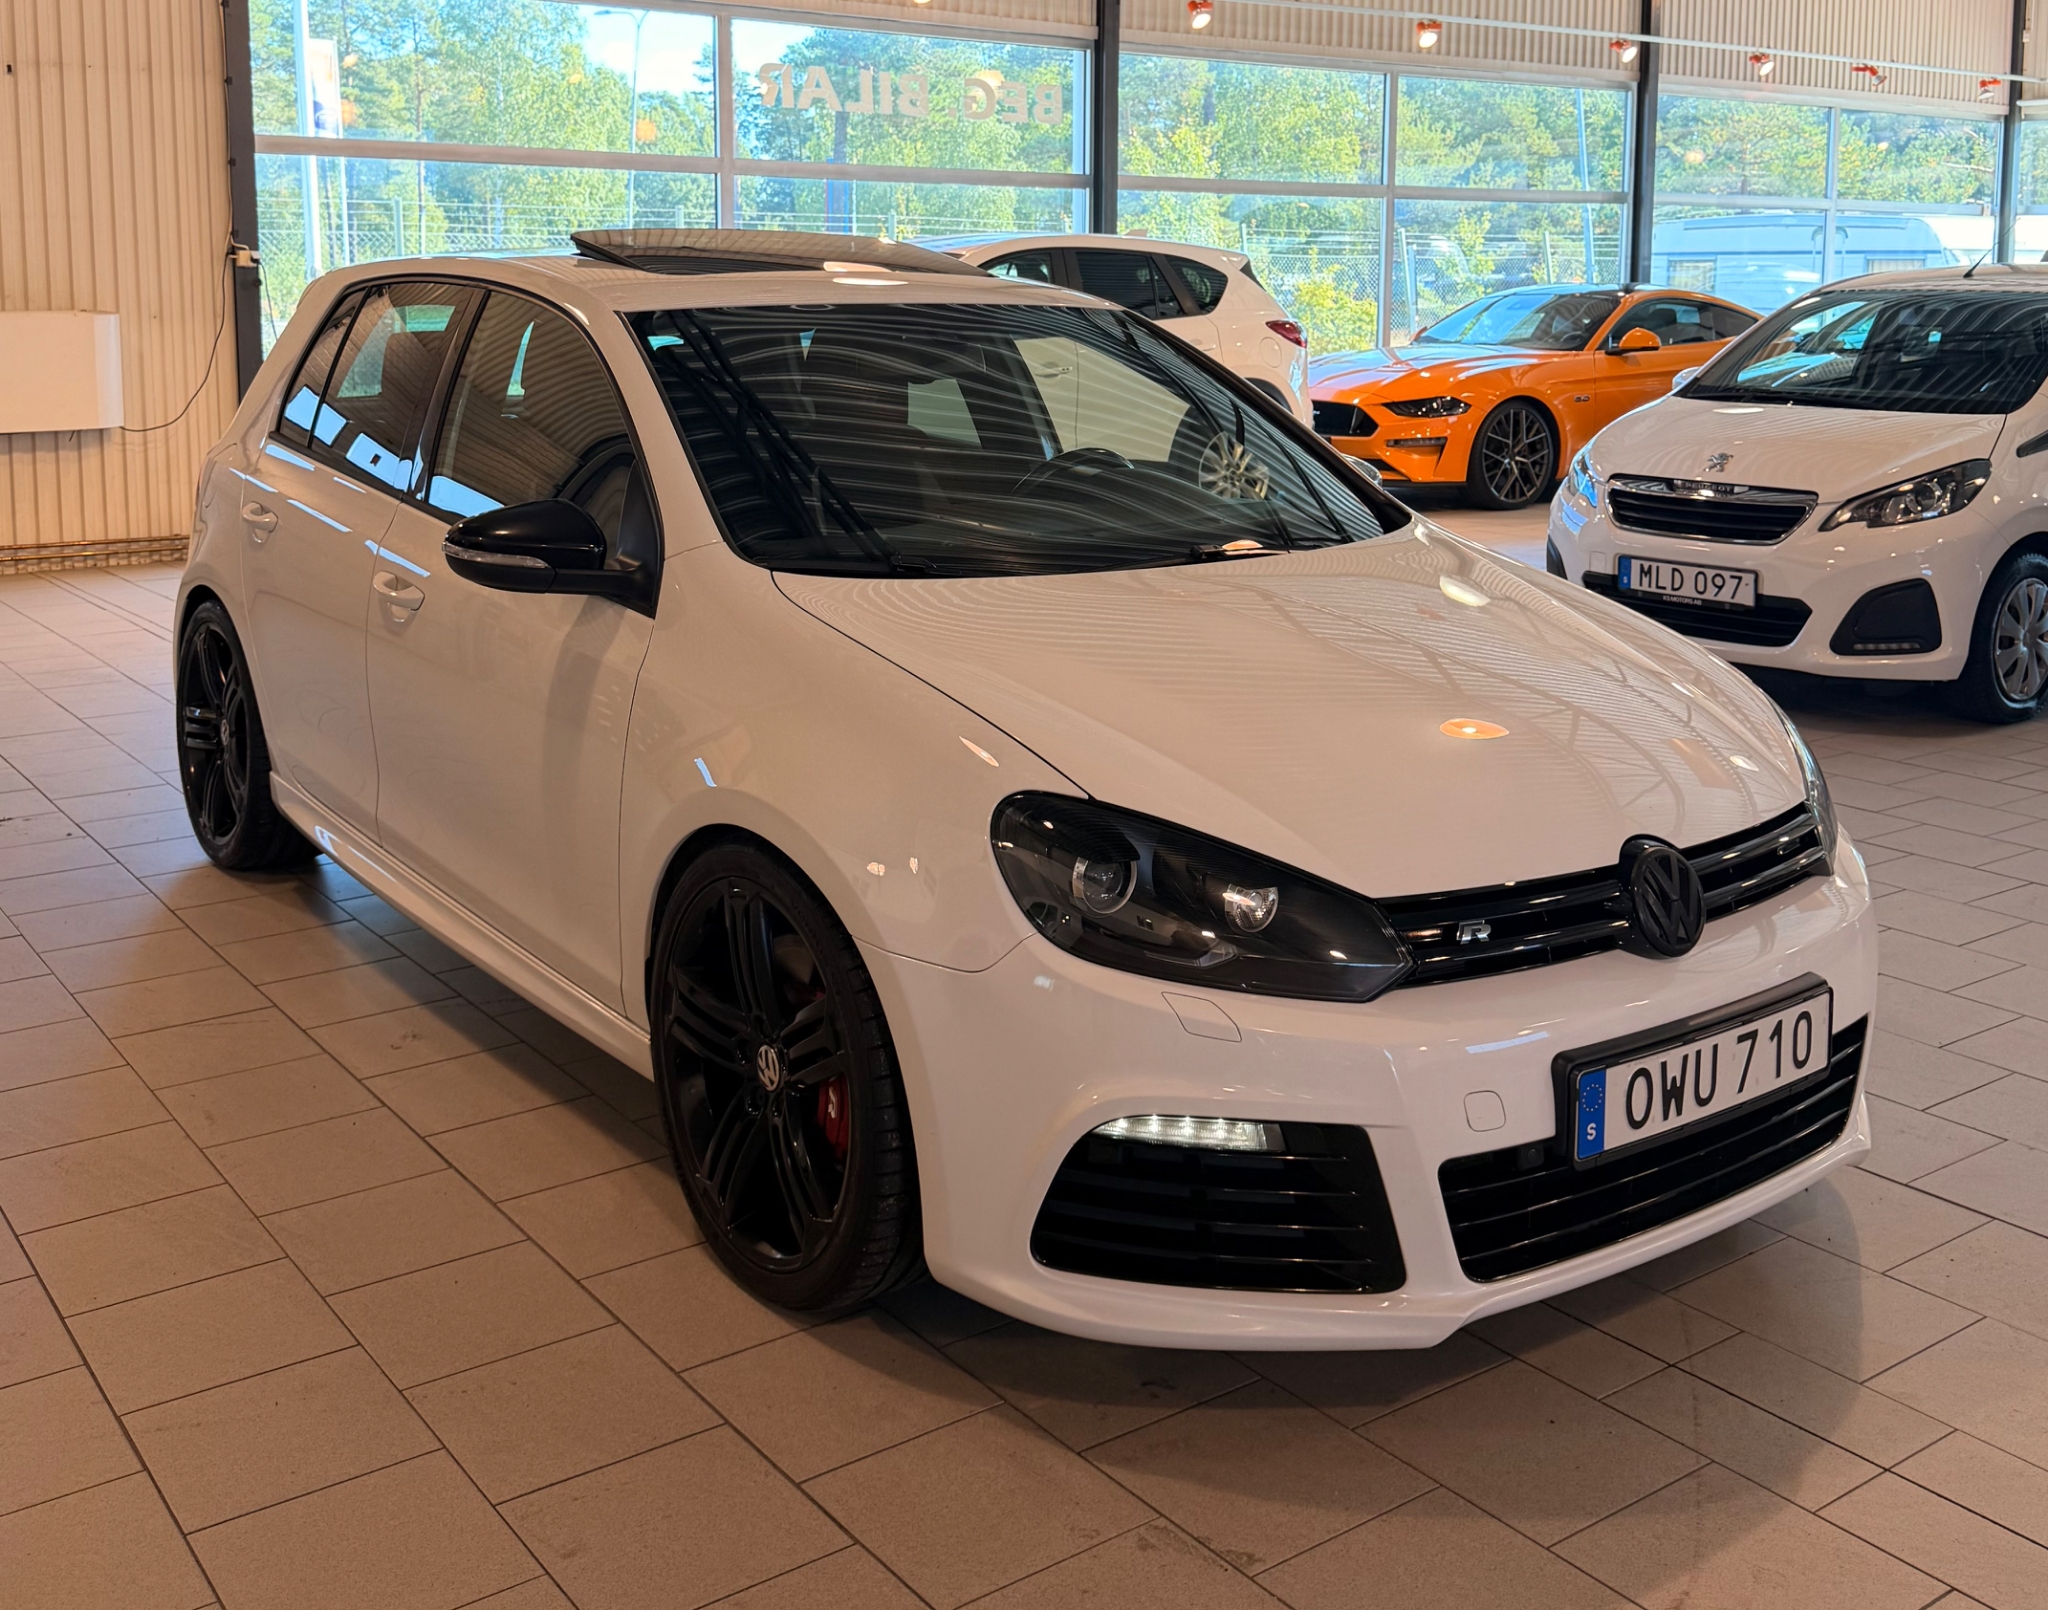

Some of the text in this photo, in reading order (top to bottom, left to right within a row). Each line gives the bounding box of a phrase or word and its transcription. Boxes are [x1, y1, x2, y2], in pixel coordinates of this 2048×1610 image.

[1639, 563, 1743, 600] MLD 097
[1456, 919, 1492, 945] R
[1625, 1010, 1813, 1130] OWU 710
[1586, 1123, 1597, 1141] S
